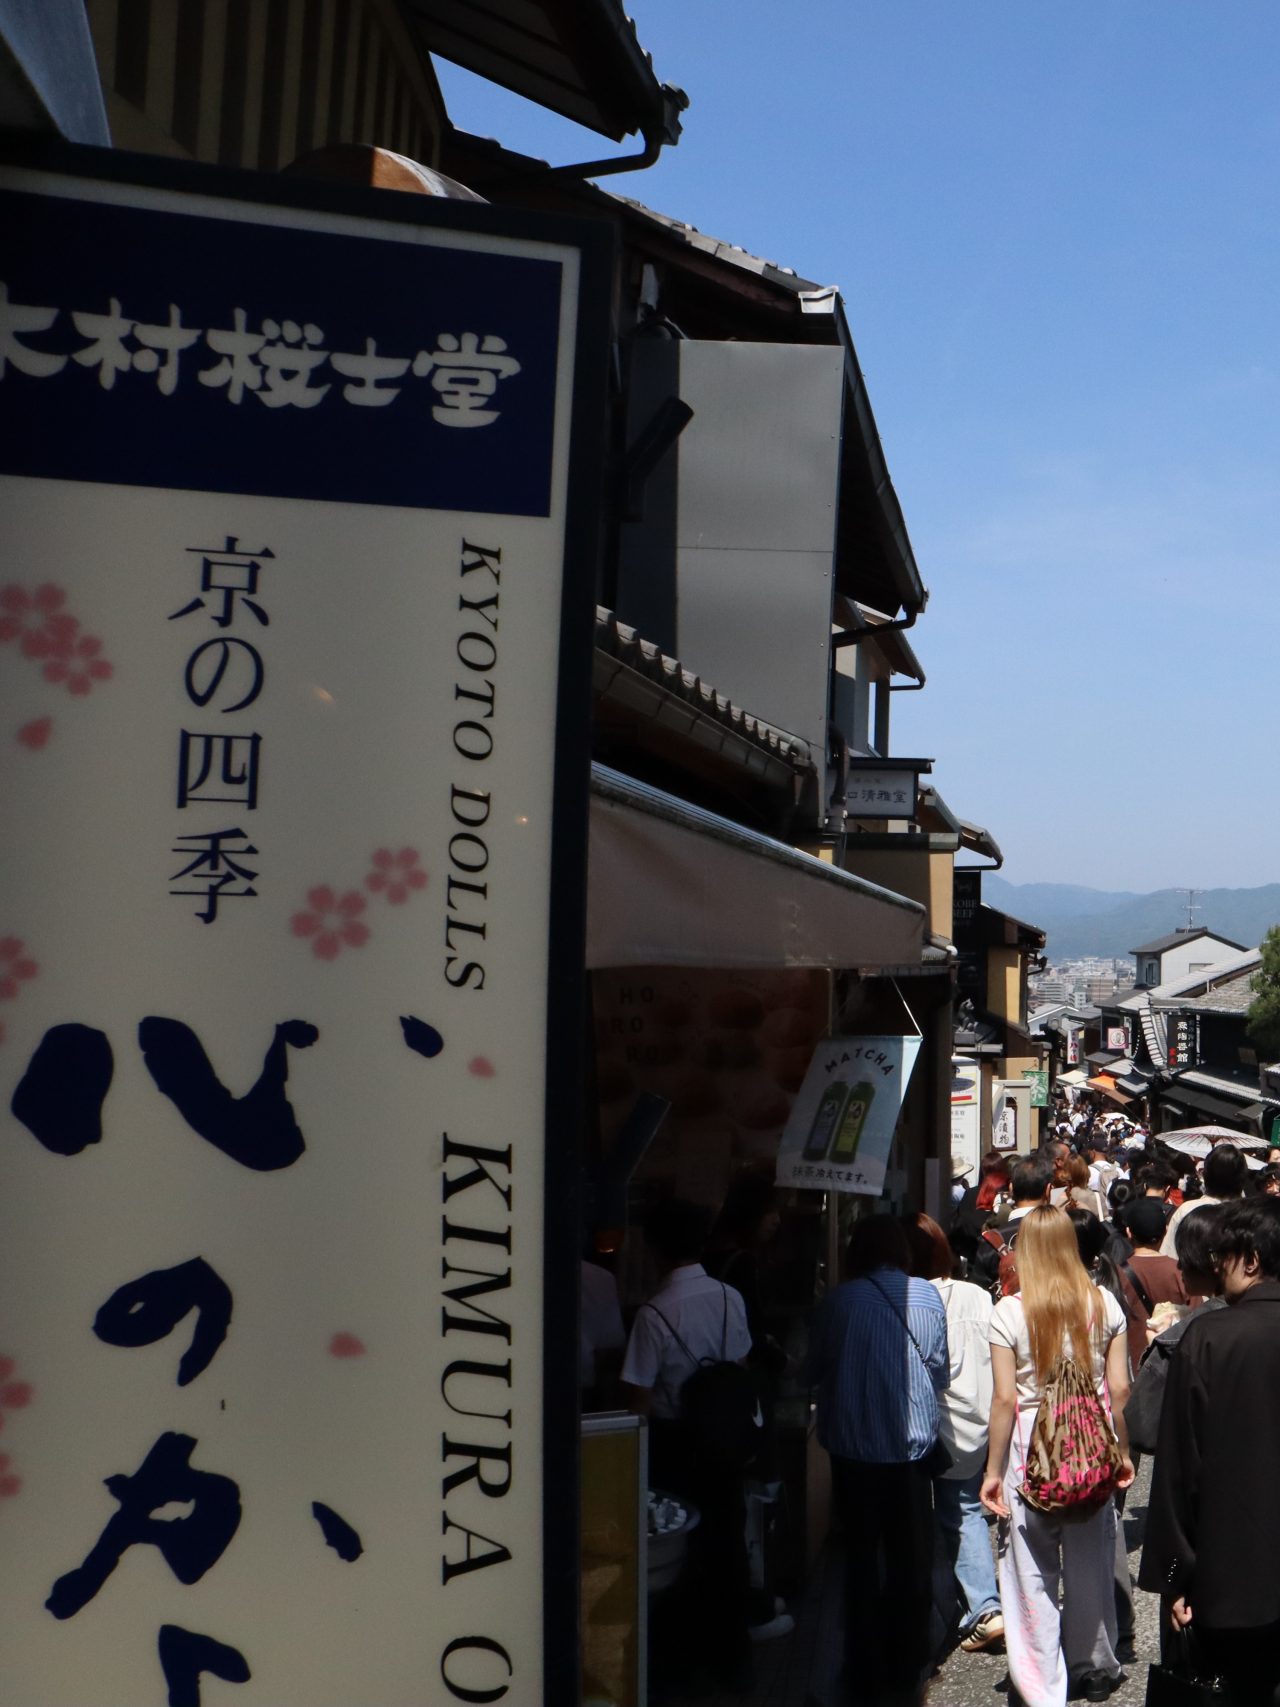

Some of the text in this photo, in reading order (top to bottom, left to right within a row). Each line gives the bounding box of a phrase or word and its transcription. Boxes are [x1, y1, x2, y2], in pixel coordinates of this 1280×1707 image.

[167, 536, 276, 924] 京の四季
[444, 537, 502, 990] KYOTO DOLLS
[824, 1047, 894, 1076] MATCHA
[440, 1131, 513, 1586] KIMURA
